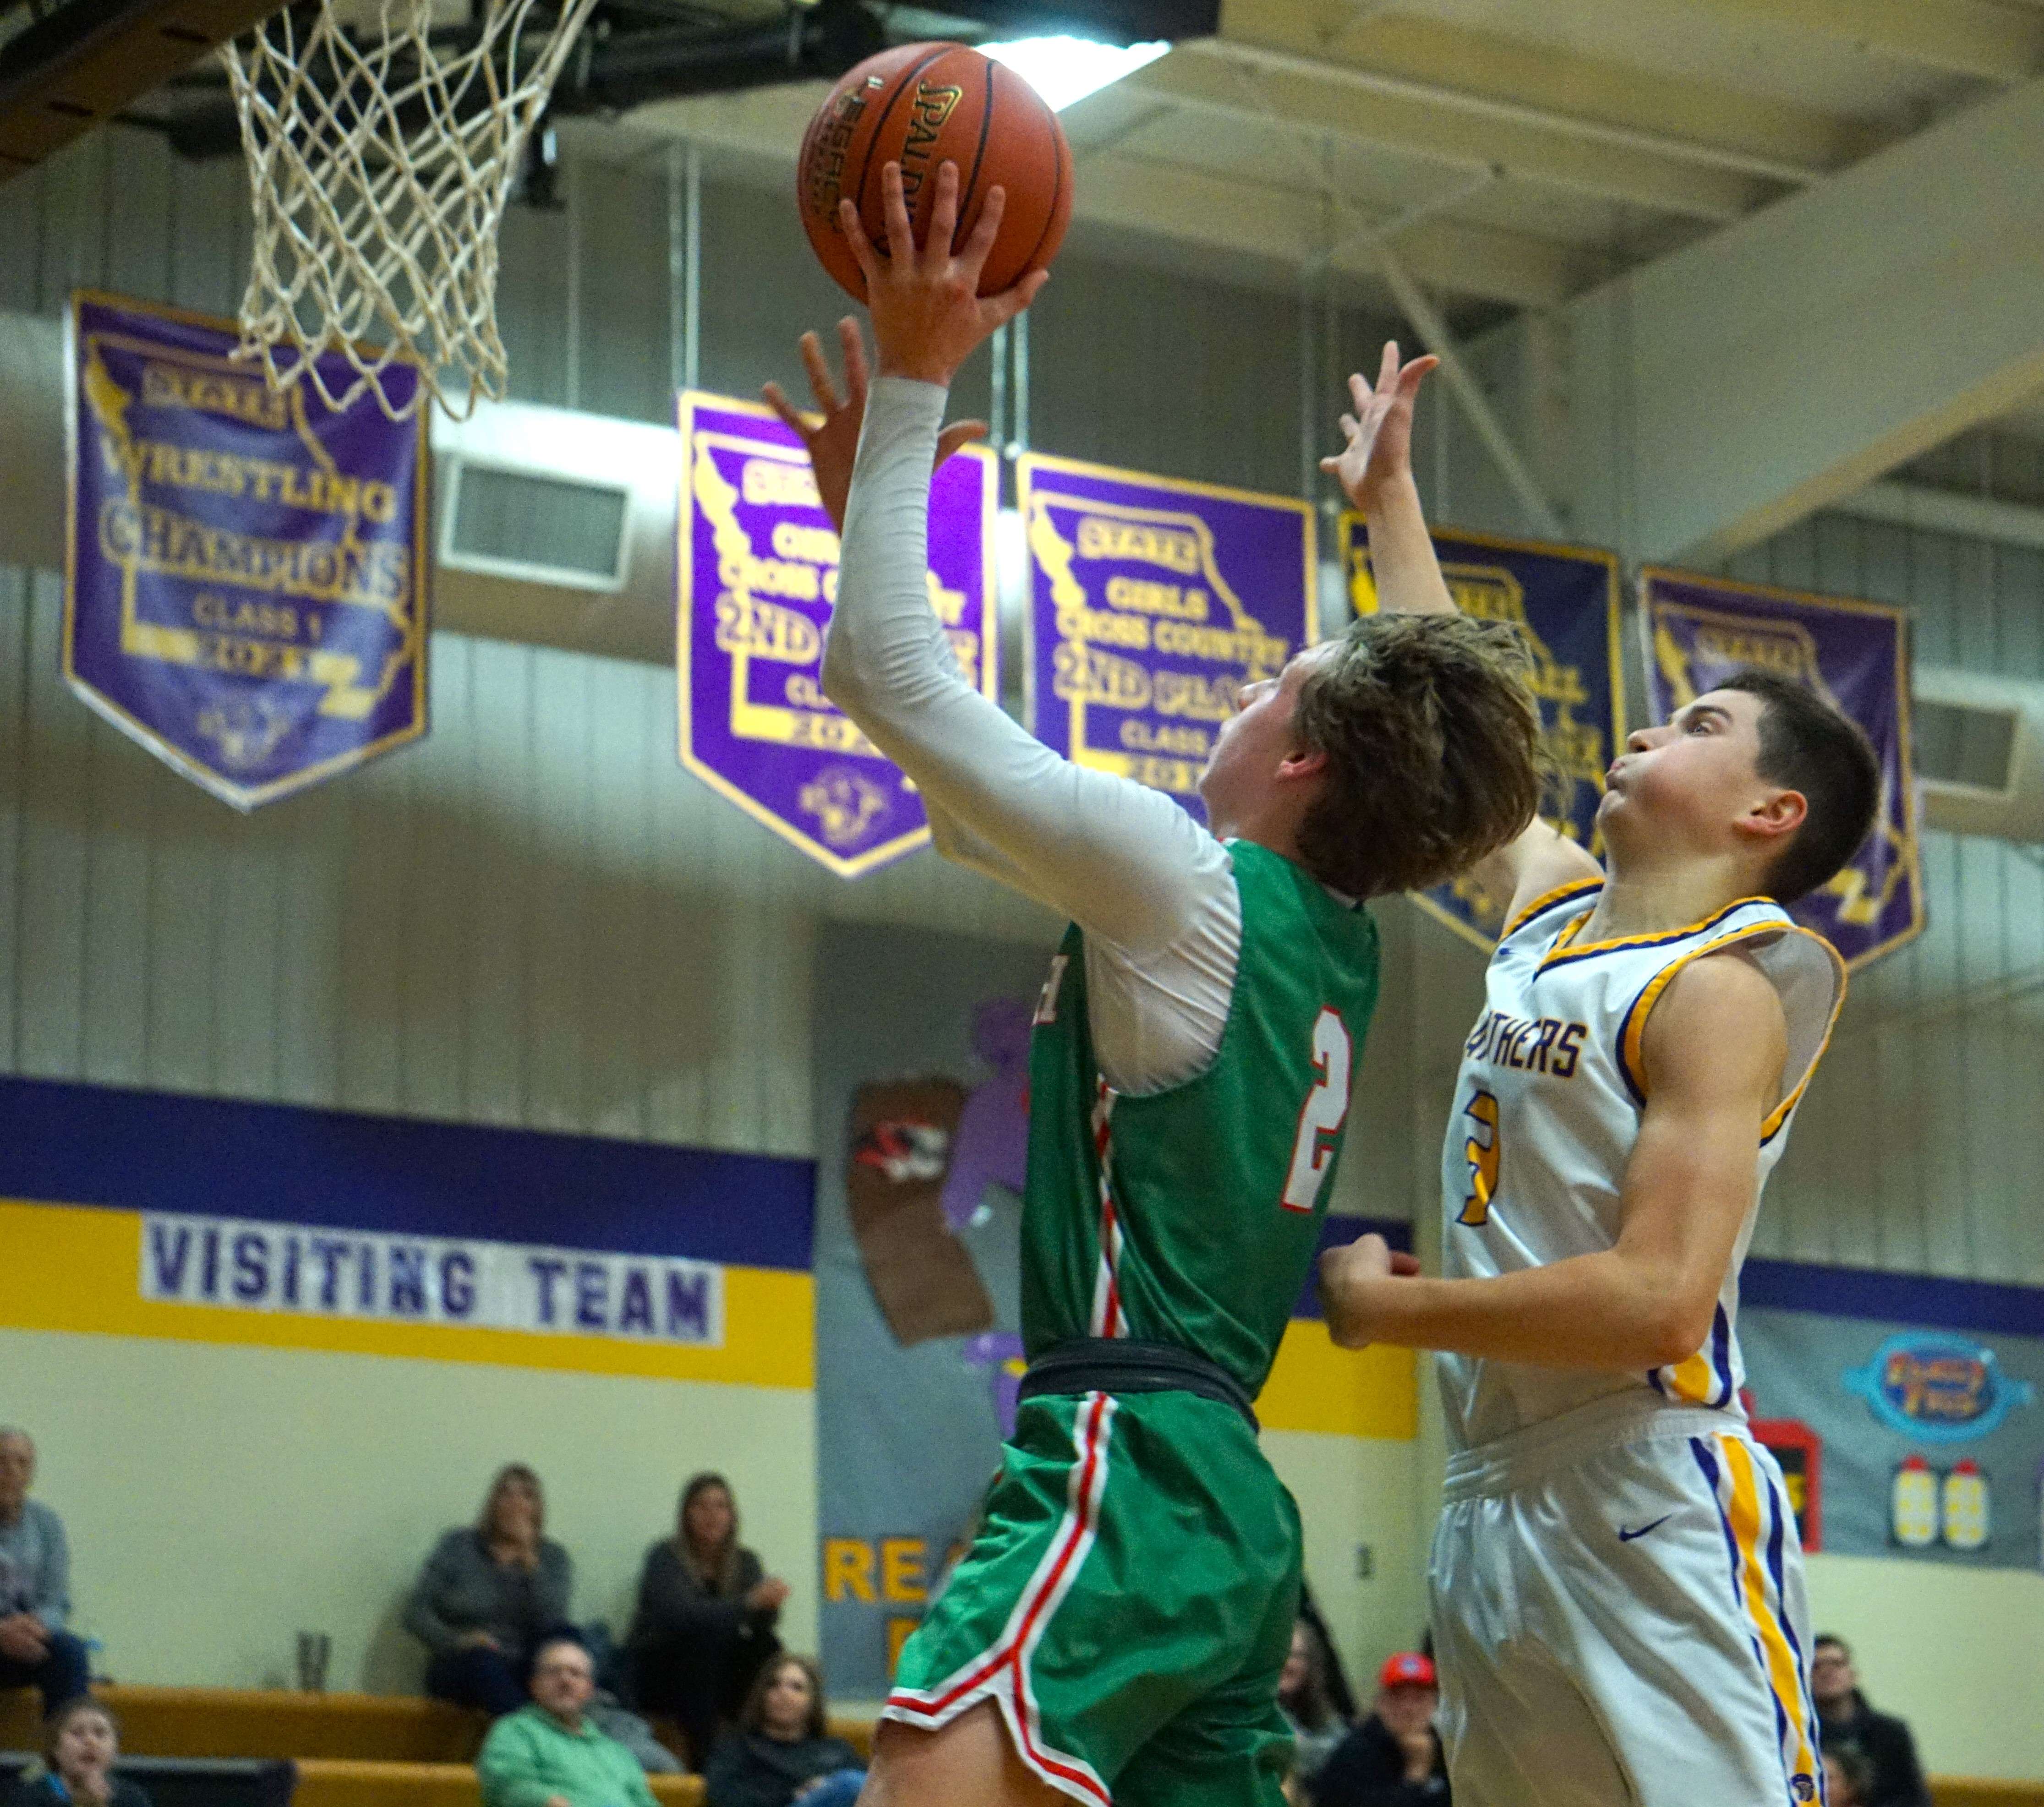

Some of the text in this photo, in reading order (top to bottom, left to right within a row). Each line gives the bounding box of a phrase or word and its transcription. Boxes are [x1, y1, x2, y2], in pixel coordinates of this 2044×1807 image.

[900, 79, 963, 224] SPALD
[101, 439, 398, 524] WRESTLING
[99, 498, 407, 607] CHAMPIONS
[194, 593, 298, 640] CLASS
[715, 589, 821, 665] 2ND
[1057, 606, 1288, 668] CROSS COUNTRY
[1106, 577, 1208, 621] GIRLS
[1054, 643, 1244, 721] 2ND PLA
[1120, 719, 1208, 756] CLASS
[1280, 1004, 1353, 1214] 2
[151, 1223, 712, 1340] VISITING TEAM
